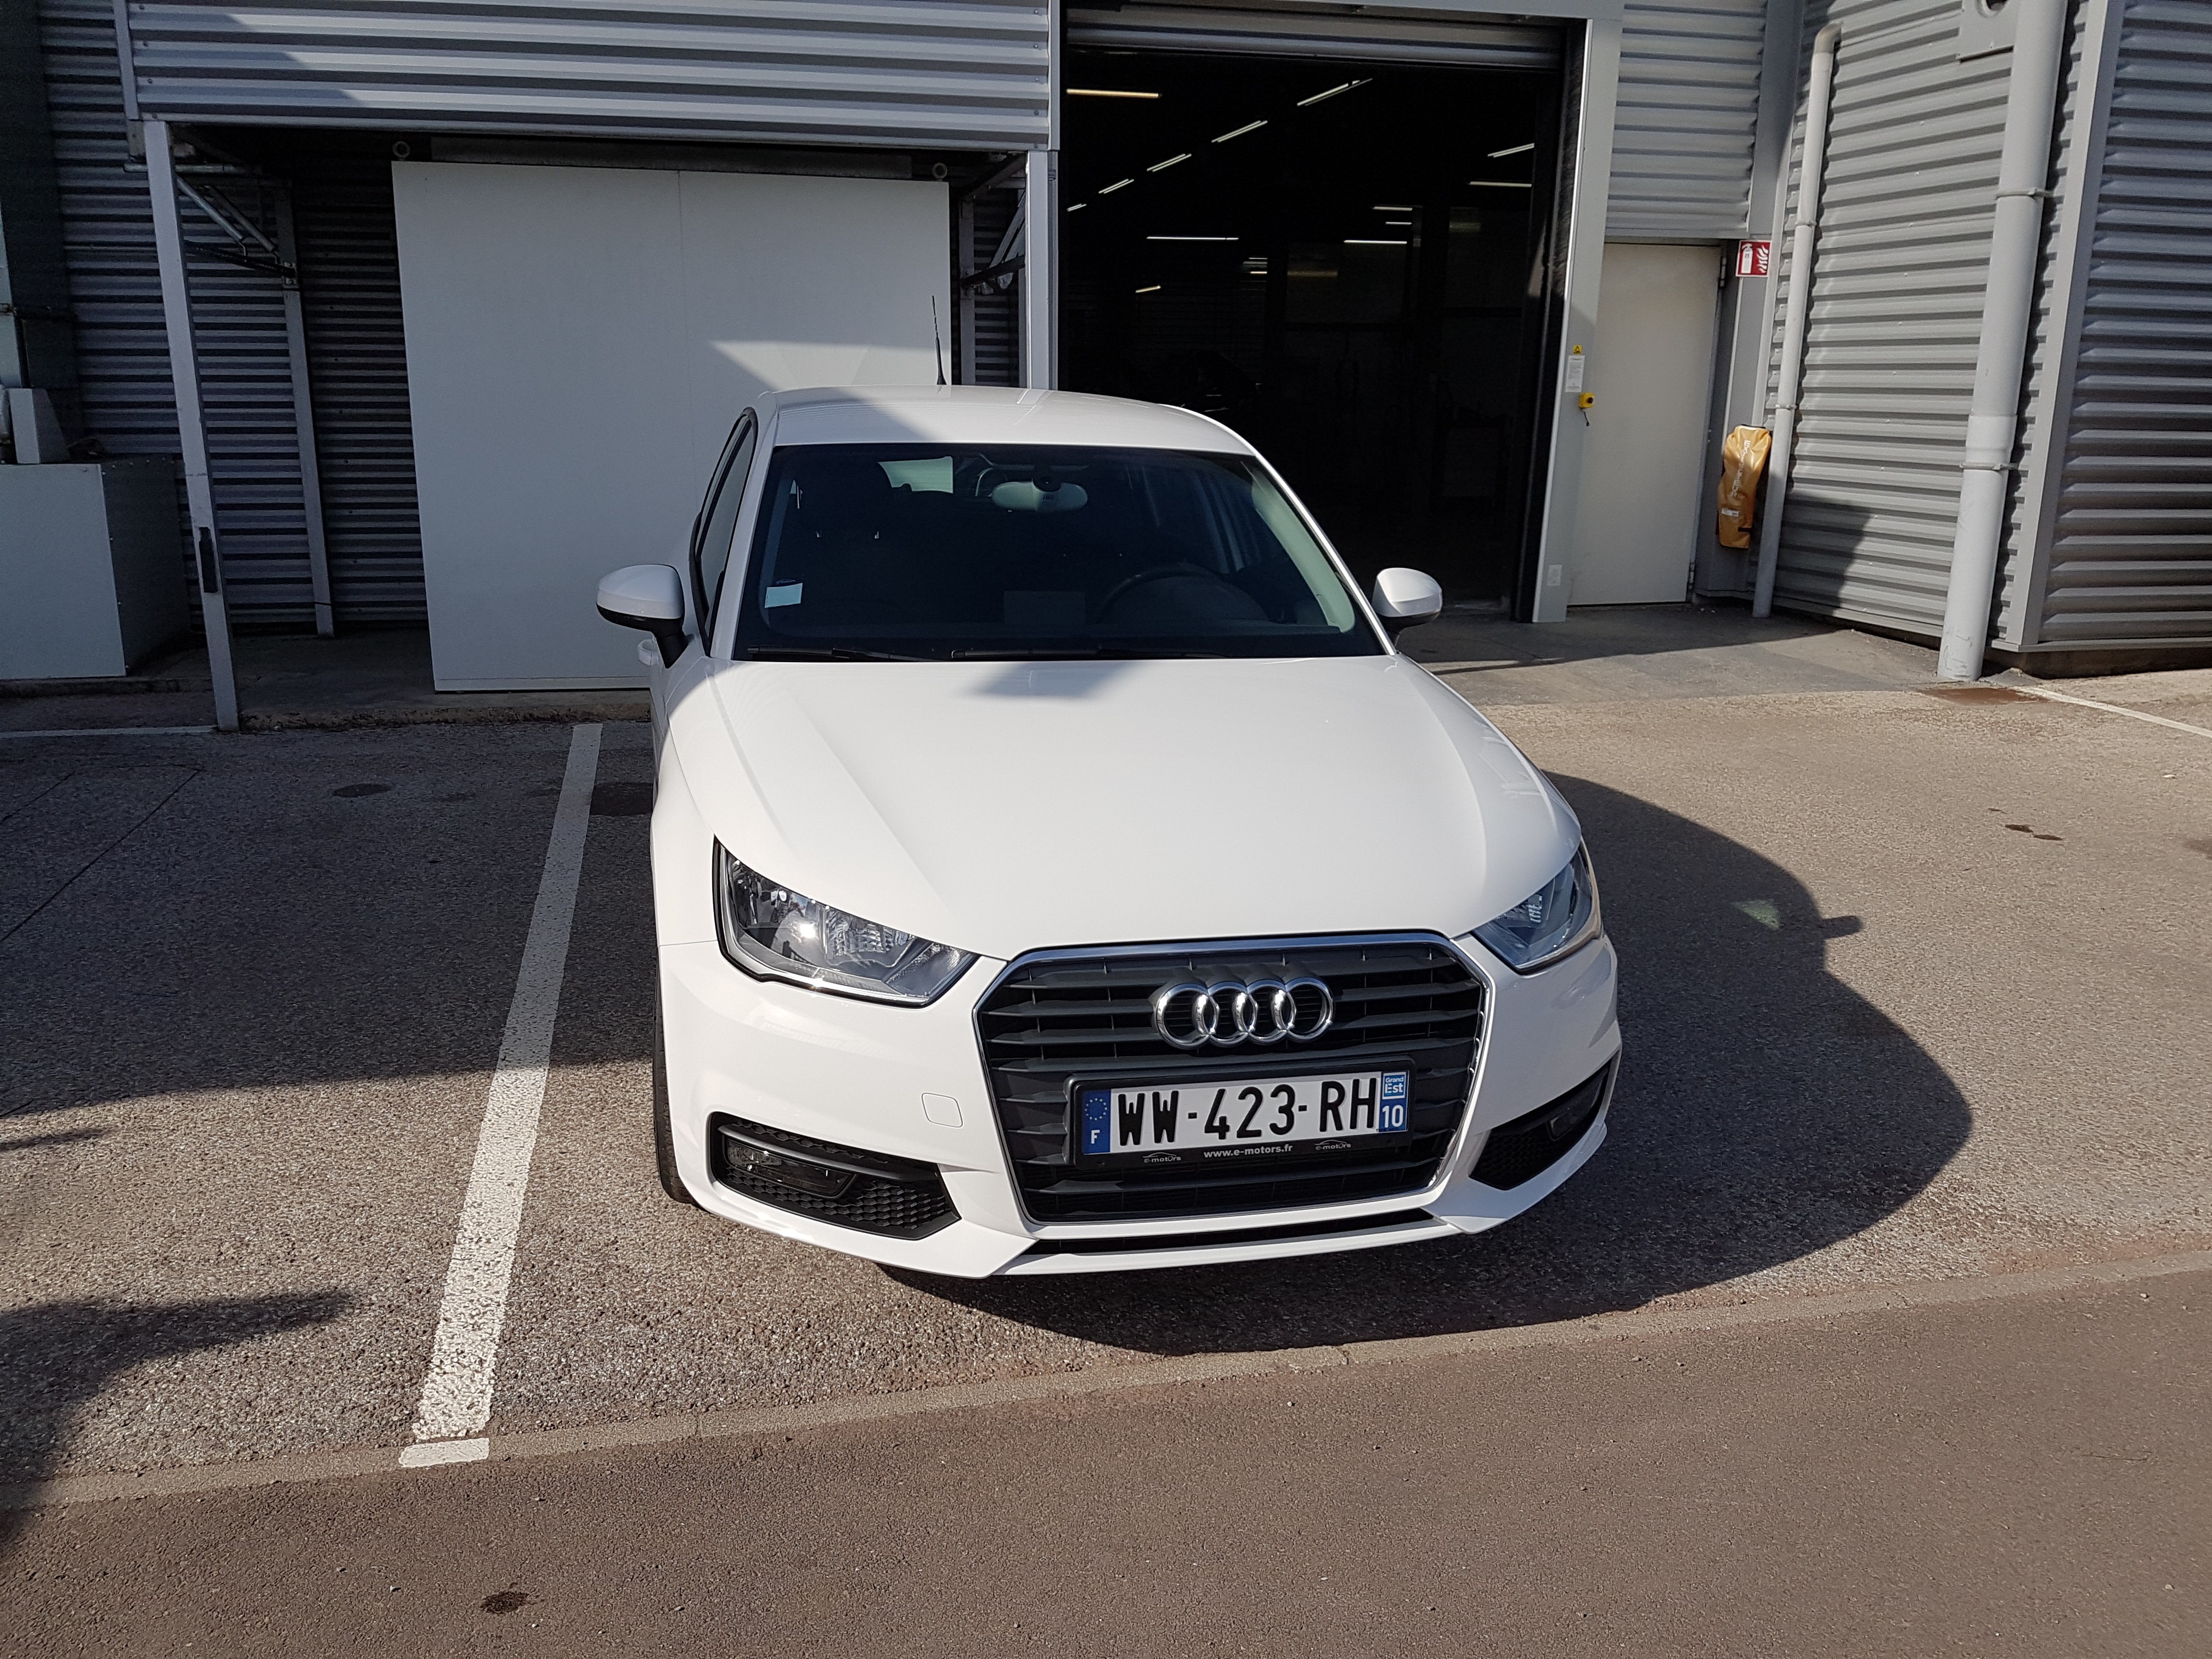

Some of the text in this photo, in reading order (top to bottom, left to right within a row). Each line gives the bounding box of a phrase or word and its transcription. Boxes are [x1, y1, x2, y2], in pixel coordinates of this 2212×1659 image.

[1385, 1082, 1403, 1094] Est
[1118, 1077, 1378, 1147] WW-423-RH
[1382, 1104, 1404, 1128] 10
[1091, 1129, 1101, 1144] F
[1203, 1143, 1293, 1158] www.e-motors.fr
